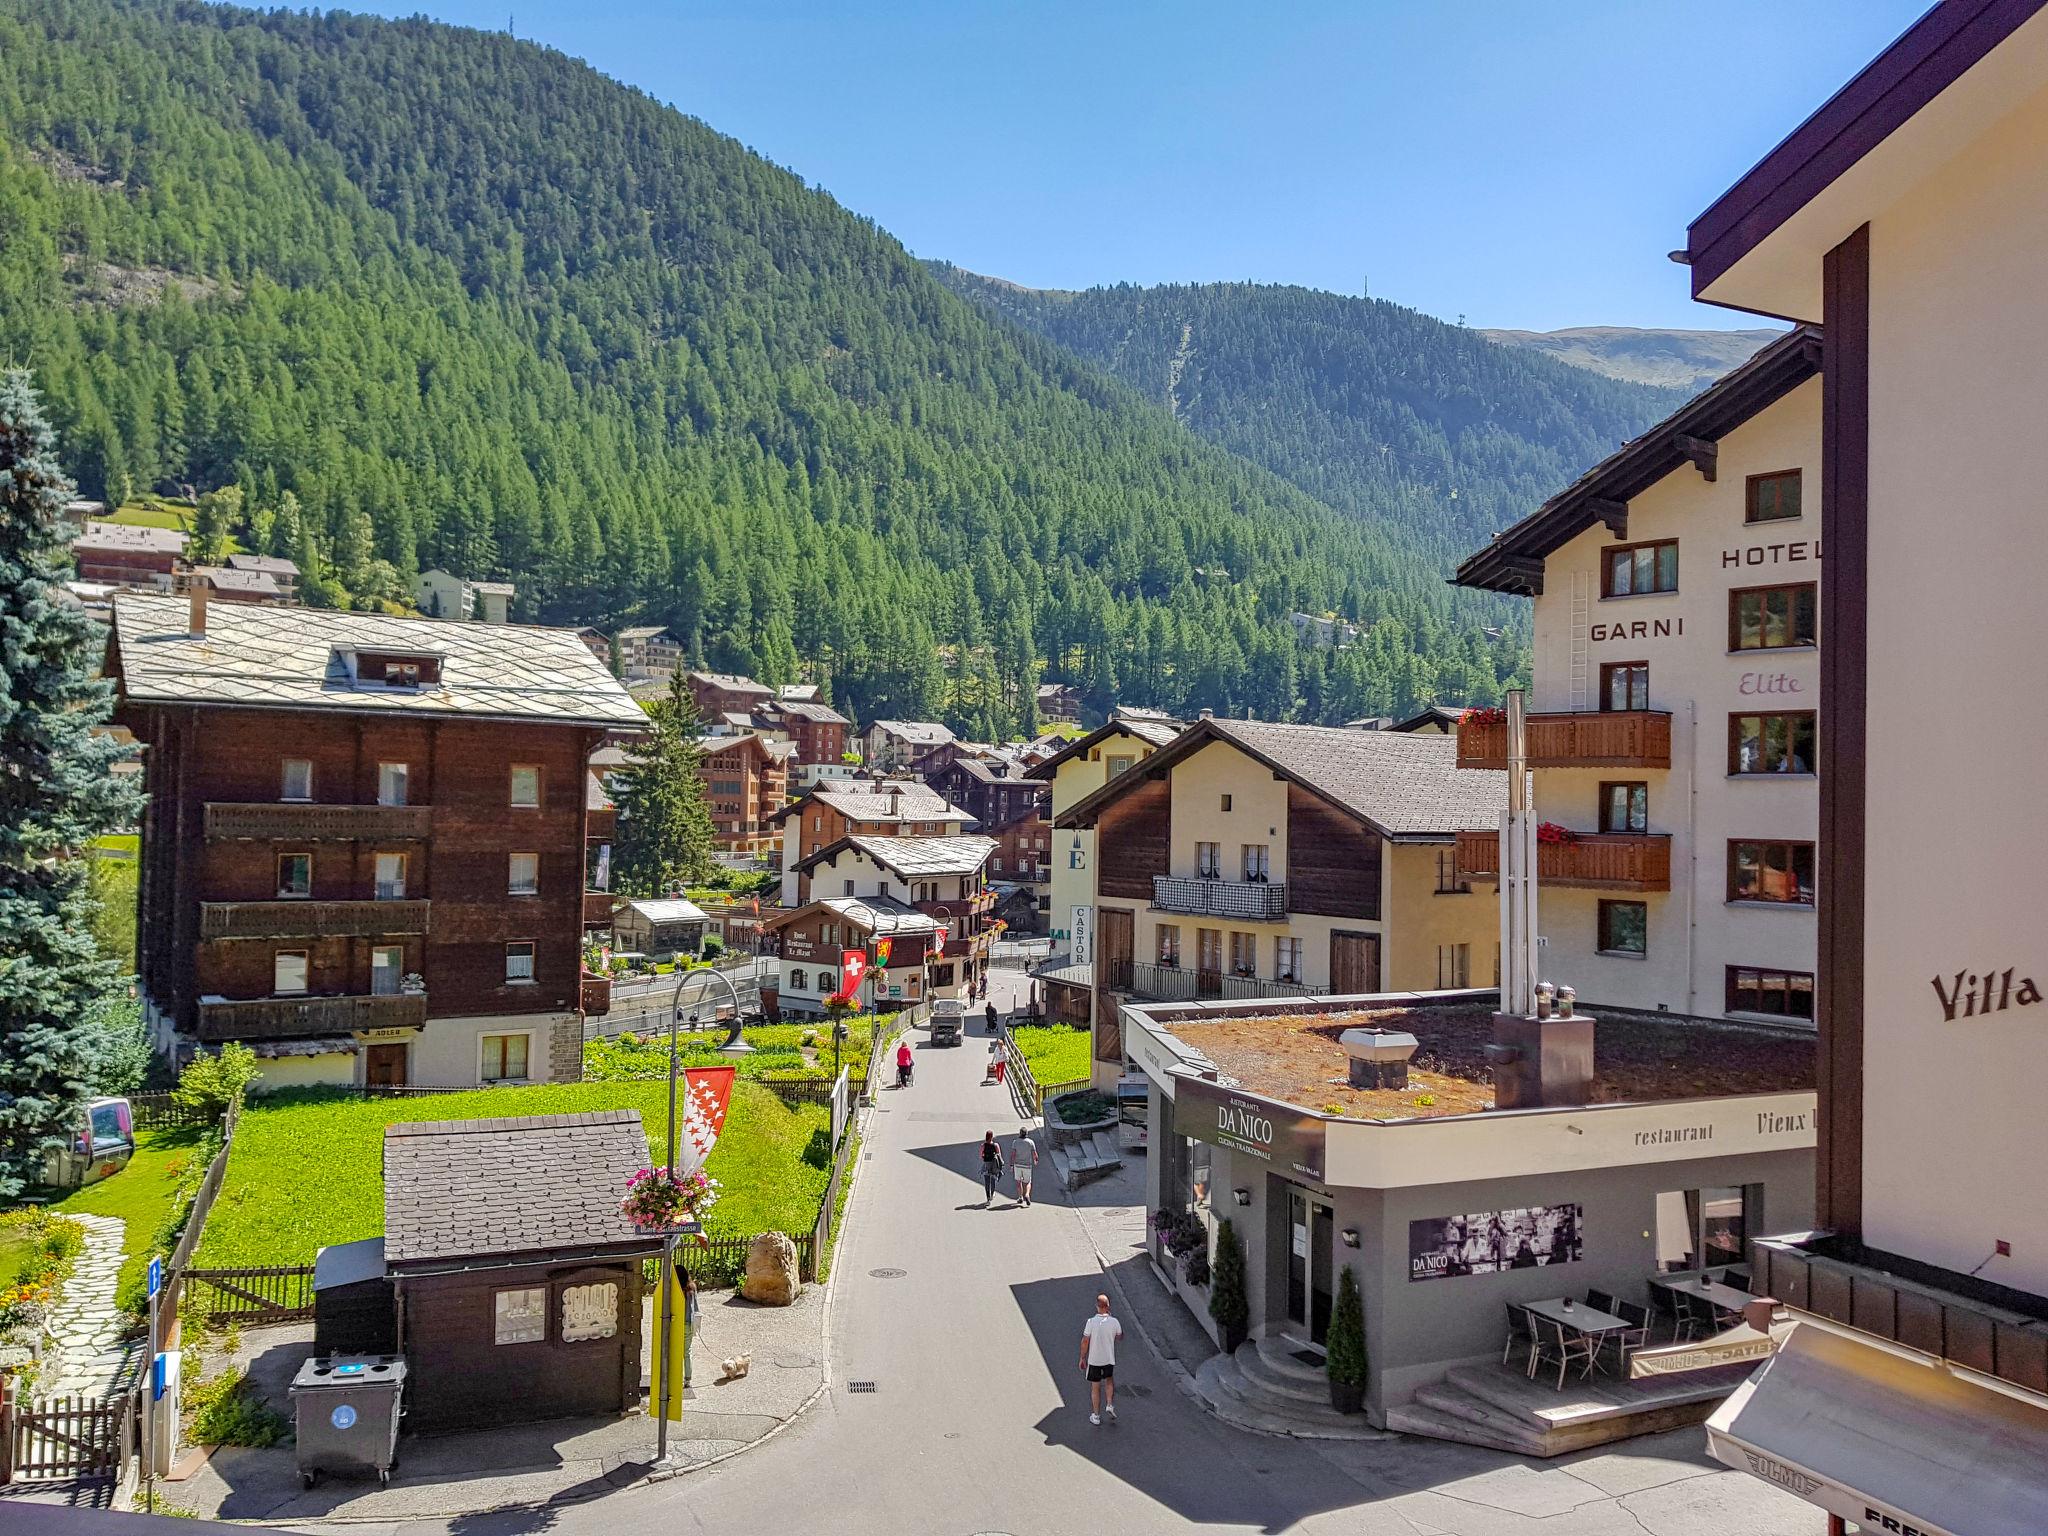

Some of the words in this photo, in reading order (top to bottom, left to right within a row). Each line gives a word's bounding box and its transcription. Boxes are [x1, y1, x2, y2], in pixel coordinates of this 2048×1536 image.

[1722, 541, 1823, 568] HOTEL
[1591, 618, 1683, 642] GARNI
[1739, 672, 1804, 695] Elite
[1068, 850, 1086, 869] E
[1076, 908, 1085, 963] CASTOR
[1931, 966, 2043, 1022] Villa
[1218, 1106, 1236, 1133] DA
[1239, 1108, 1272, 1144] NICO
[1635, 1124, 1713, 1146] restaurant
[1757, 1111, 1806, 1135] Vieux
[1413, 1257, 1425, 1270] DA
[1426, 1256, 1448, 1269] NICO
[1757, 1456, 1807, 1493] OLMO
